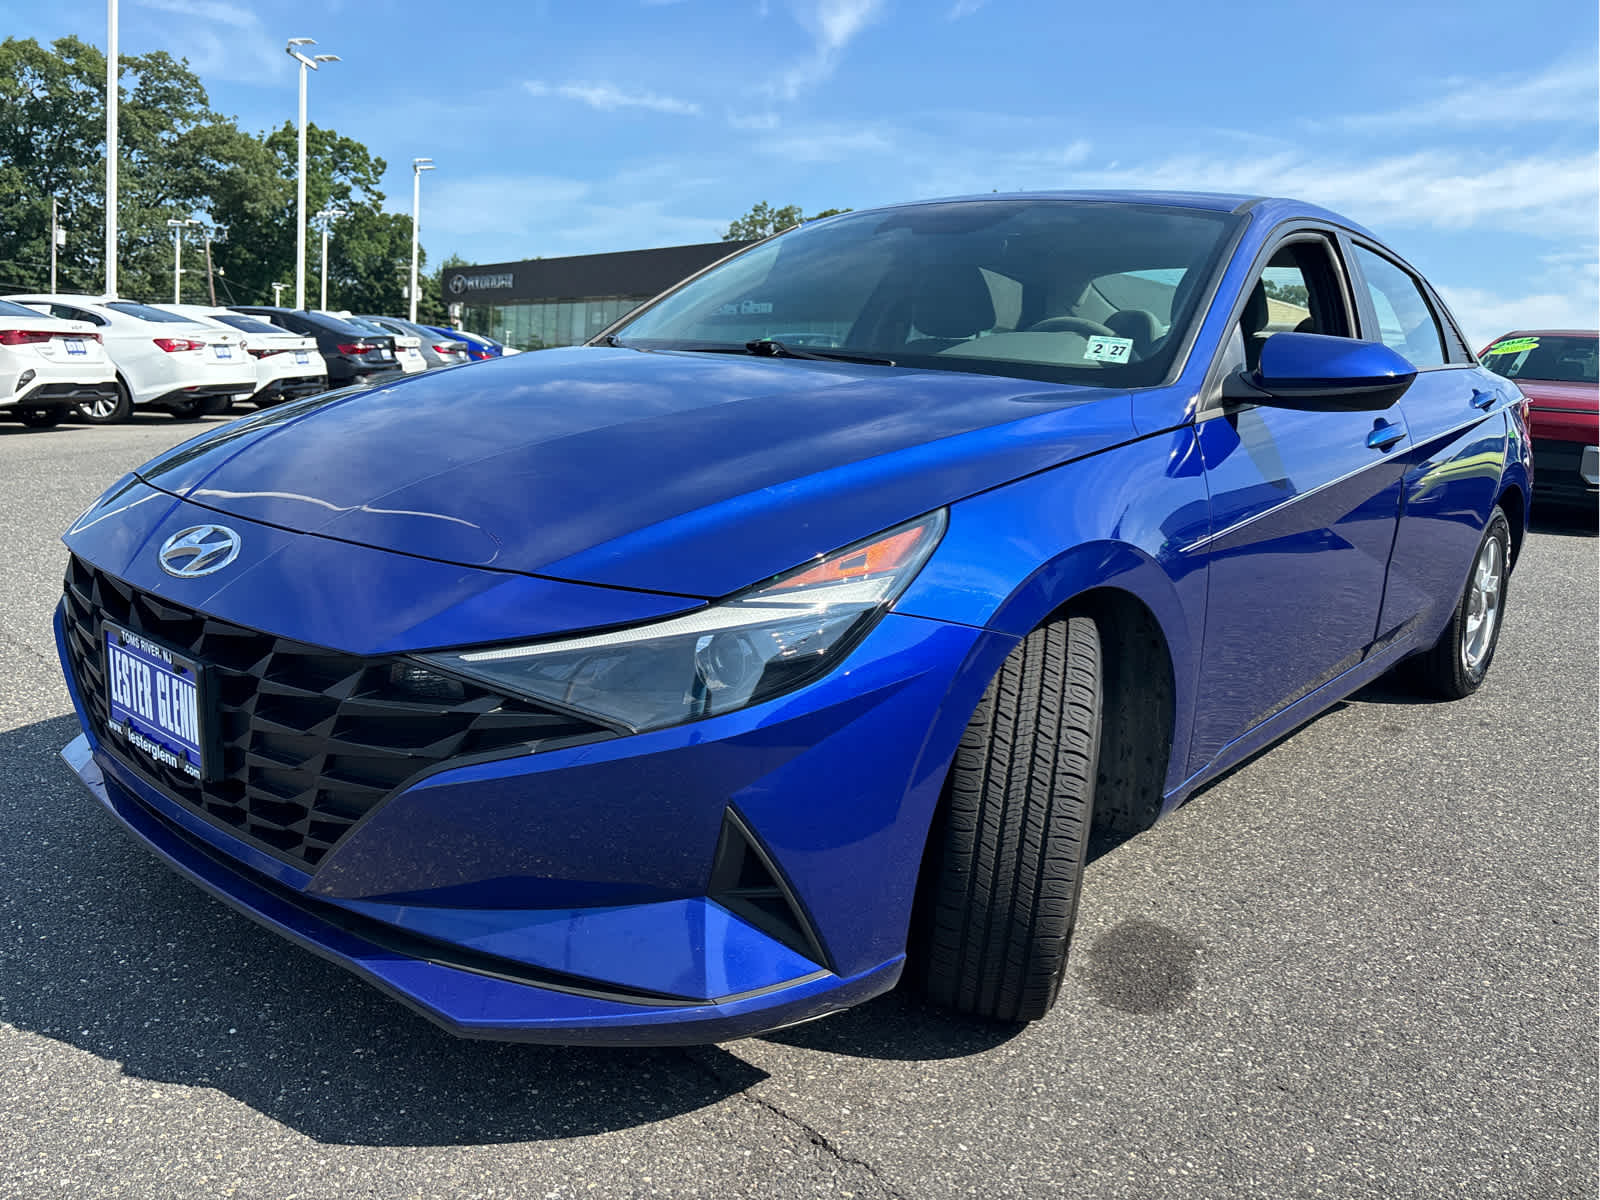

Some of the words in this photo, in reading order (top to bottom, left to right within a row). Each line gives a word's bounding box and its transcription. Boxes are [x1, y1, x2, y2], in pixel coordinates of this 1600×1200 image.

[1093, 343, 1103, 354] 2
[1110, 345, 1127, 356] 27
[121, 630, 140, 649] TOMS
[162, 650, 173, 665] NJ
[109, 648, 154, 721] LESTER
[156, 671, 199, 746] GLENN
[128, 727, 178, 768] lesterglenn
